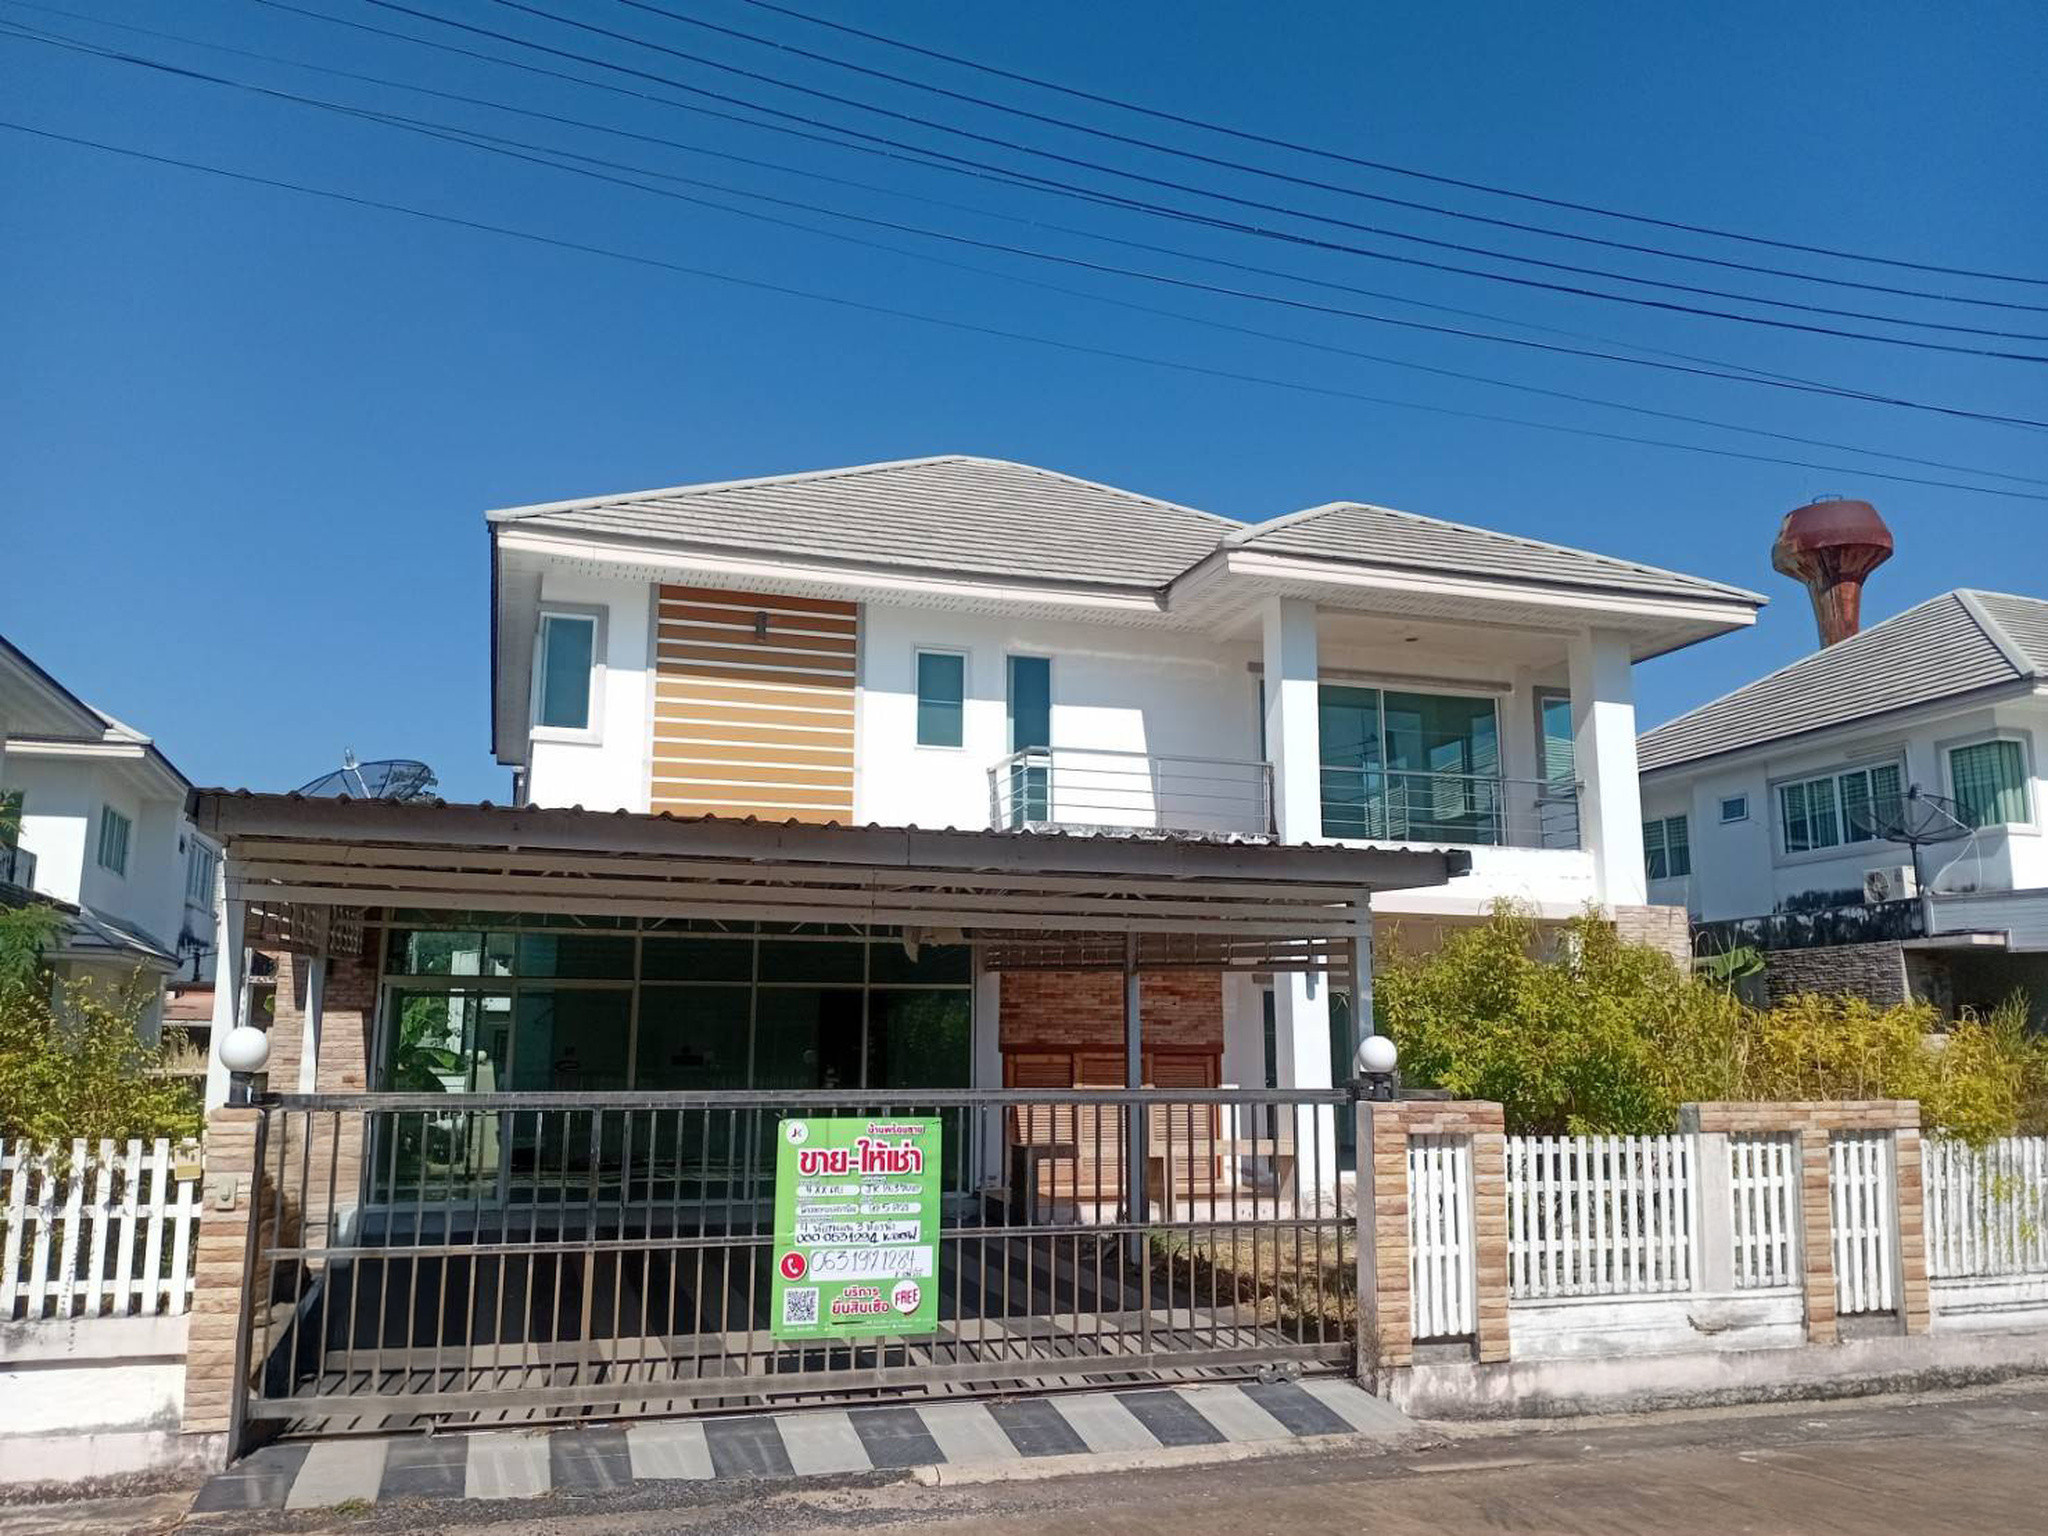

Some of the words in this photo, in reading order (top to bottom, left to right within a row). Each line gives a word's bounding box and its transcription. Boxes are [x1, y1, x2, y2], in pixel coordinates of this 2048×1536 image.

[799, 1138, 922, 1174] ขาย-ให้เช่า
[895, 1288, 919, 1306] FREE
